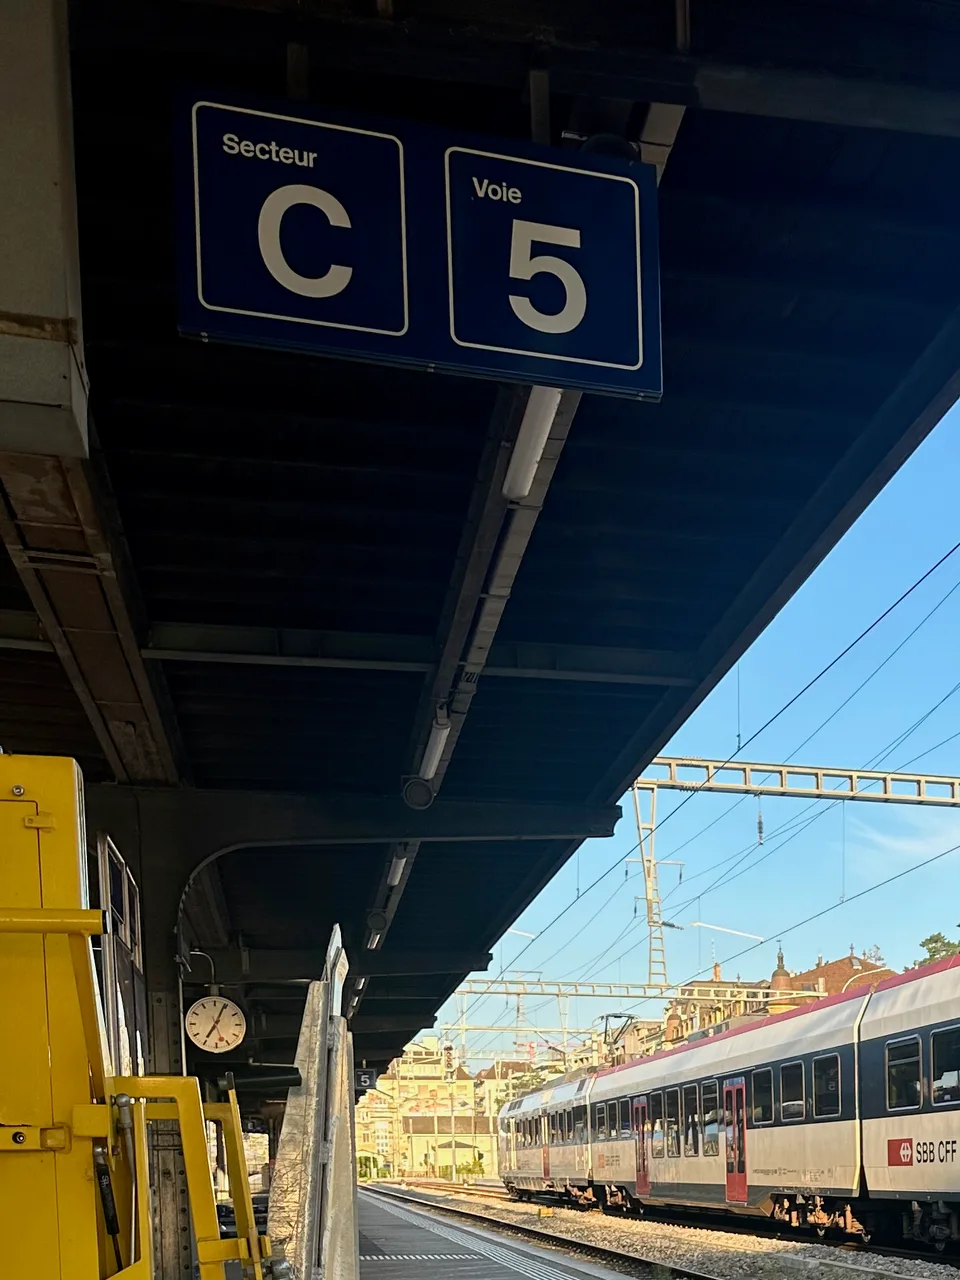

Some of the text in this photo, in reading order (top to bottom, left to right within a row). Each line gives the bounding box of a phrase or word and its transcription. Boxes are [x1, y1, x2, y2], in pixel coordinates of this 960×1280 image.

[222, 133, 318, 168] Secteur
[472, 176, 522, 204] Voie
[257, 184, 353, 298] C
[508, 218, 587, 334] 5
[361, 1075, 370, 1086] 5
[916, 1142, 935, 1163] SBB
[938, 1141, 957, 1163] CFF
